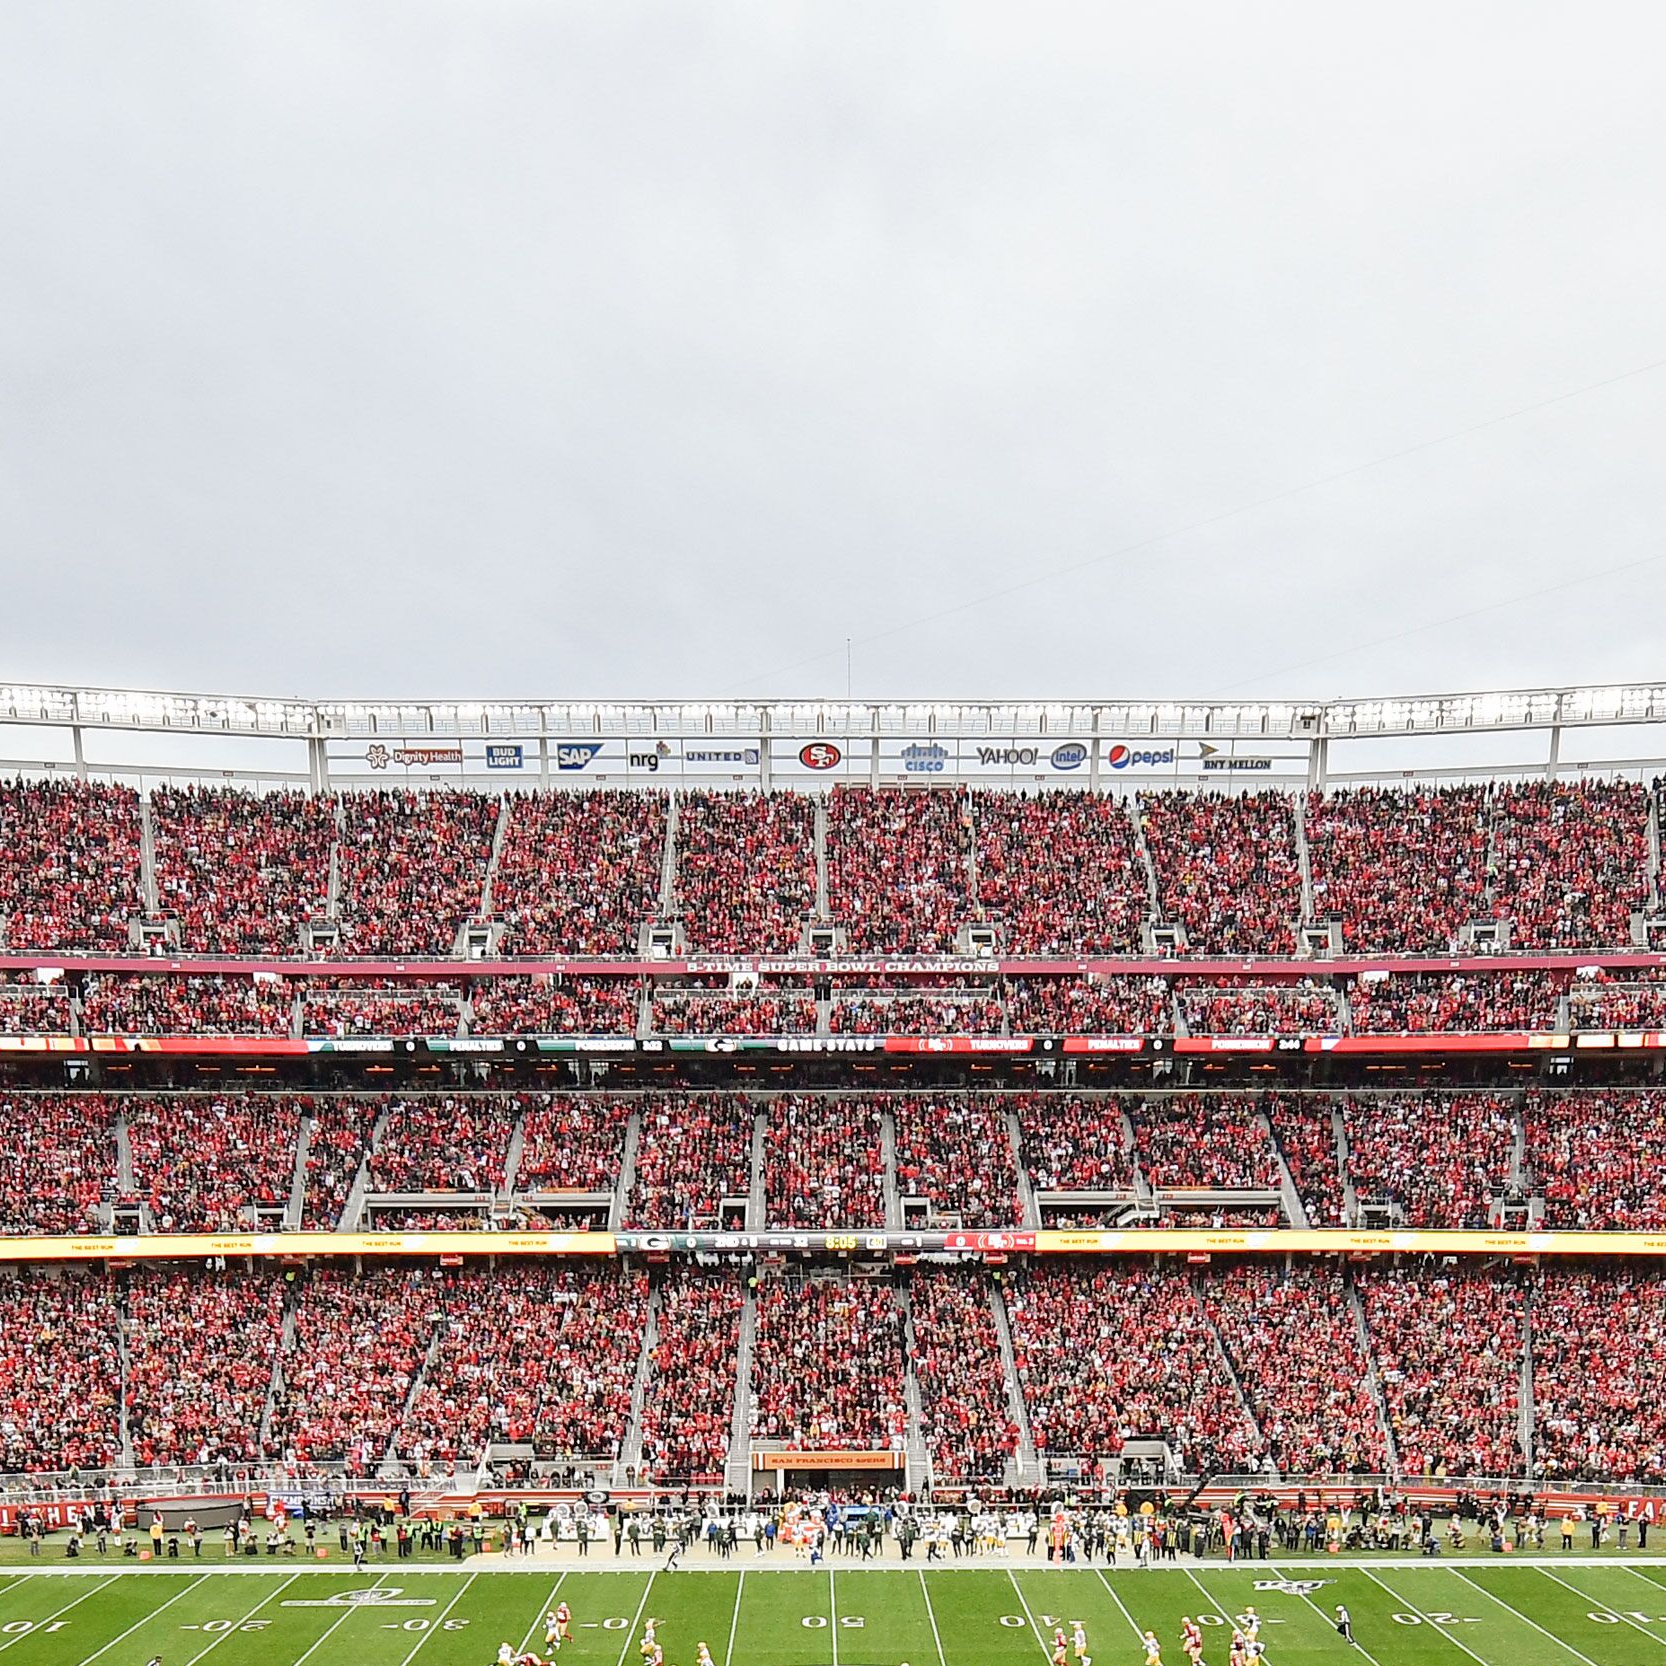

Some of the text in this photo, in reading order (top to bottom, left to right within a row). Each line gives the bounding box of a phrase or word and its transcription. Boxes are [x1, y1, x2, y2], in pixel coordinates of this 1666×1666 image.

[394, 750, 461, 765] Dignity Health
[492, 747, 515, 756] BUD
[558, 747, 591, 765] SAP
[686, 752, 741, 761] UNITED
[978, 747, 1039, 765] YAHOO!
[1055, 748, 1081, 764] intel
[1132, 748, 1174, 766] pepsi
[489, 756, 520, 767] LIGHT
[630, 754, 658, 771] nrg
[1203, 759, 1272, 771] BNY MELLON
[758, 962, 820, 972] SUPER
[825, 962, 880, 972] BOWL
[885, 962, 999, 972] CHAMPIONS
[777, 1039, 875, 1051] GAME STATS
[825, 1236, 857, 1249] 8:05
